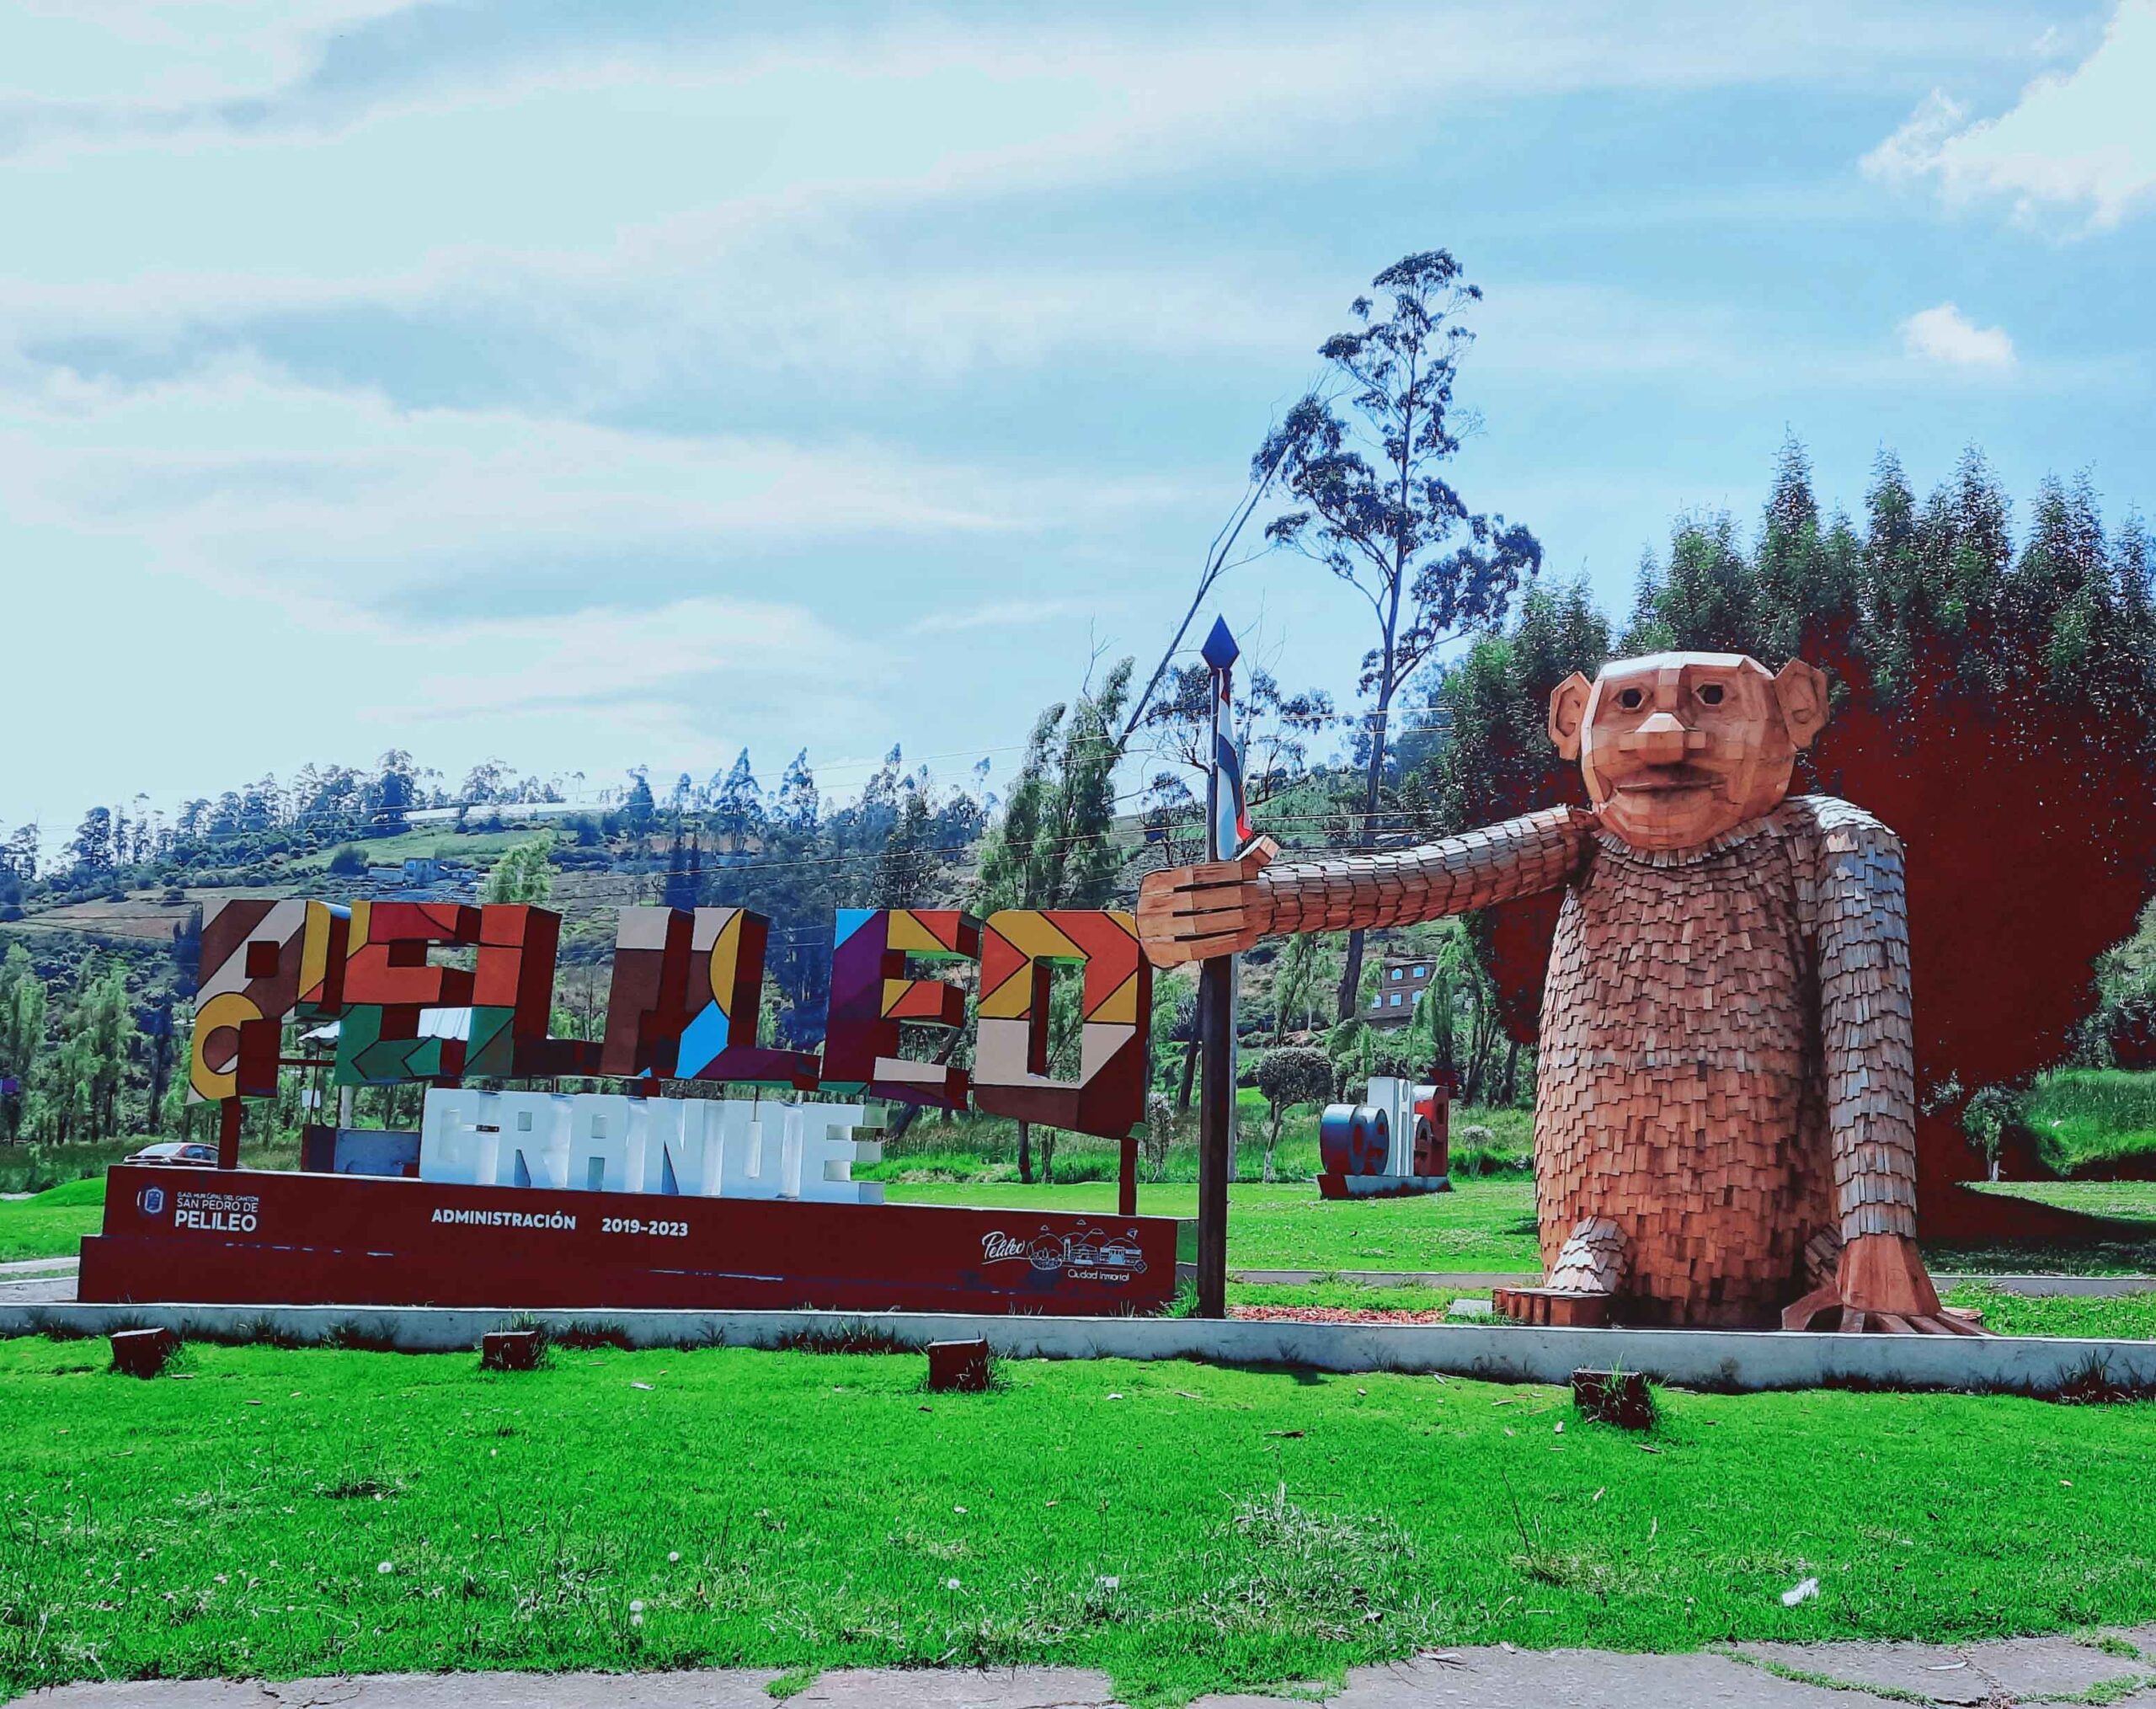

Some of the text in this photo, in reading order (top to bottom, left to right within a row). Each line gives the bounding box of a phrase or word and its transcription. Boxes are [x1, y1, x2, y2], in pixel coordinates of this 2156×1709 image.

[185, 899, 1150, 1133] PELILEO
[419, 1088, 888, 1203] GRANDE
[176, 1198, 259, 1213] SAN PEDRO DE
[174, 1210, 257, 1232] PELILEO
[431, 1209, 689, 1236] ADMINISTRACIÓN 2019-2023
[981, 1231, 1026, 1259] Pelileo
